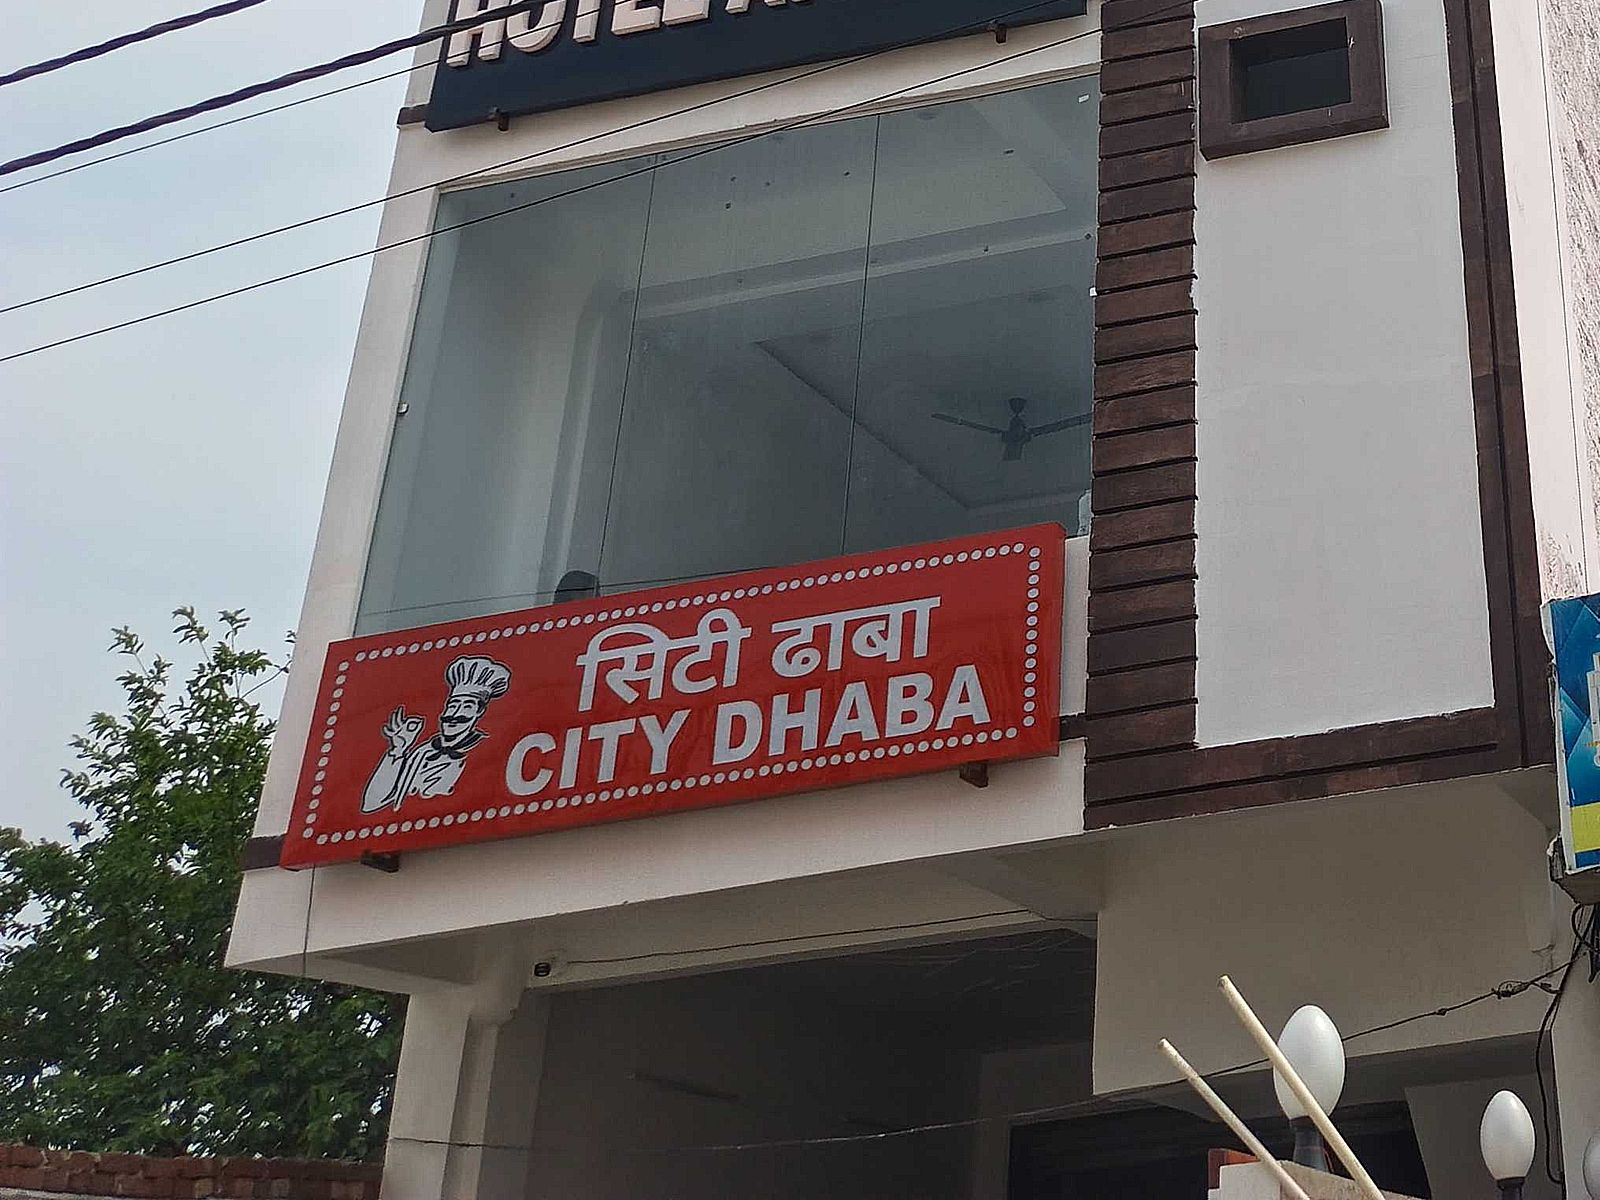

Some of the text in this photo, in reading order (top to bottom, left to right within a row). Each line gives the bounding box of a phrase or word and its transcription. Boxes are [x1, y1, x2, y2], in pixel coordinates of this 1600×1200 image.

[576, 597, 941, 712] सिटी ढाबा
[504, 664, 991, 797] CITY DHABA
